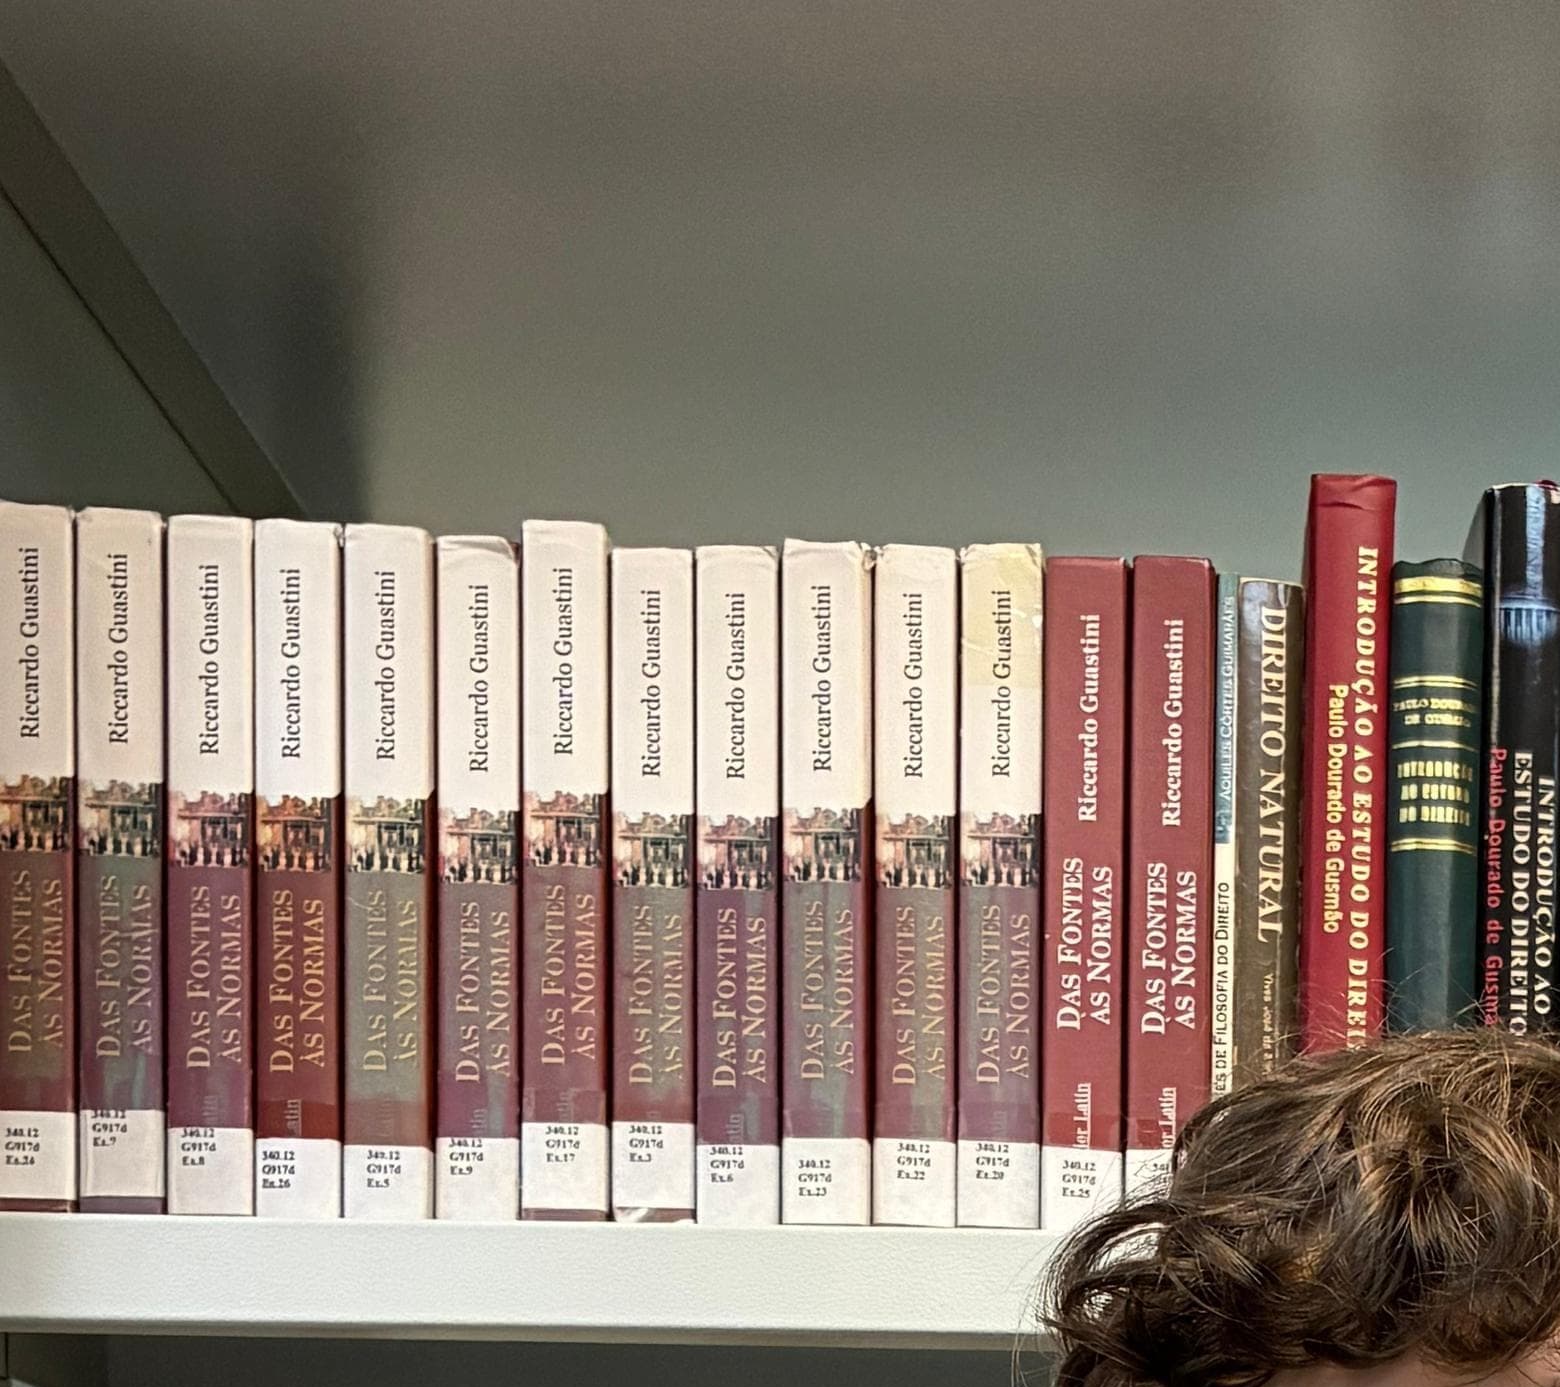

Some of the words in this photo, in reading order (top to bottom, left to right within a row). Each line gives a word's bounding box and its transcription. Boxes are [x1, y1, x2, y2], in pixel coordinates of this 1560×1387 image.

[18, 547, 39, 639] Guastini
[279, 569, 301, 659] Guastini
[810, 585, 832, 674] Guastini
[1079, 614, 1100, 713] Guastini
[1257, 604, 1287, 757] DIREITO
[1352, 546, 1379, 736] INTRODUÇÃO
[18, 644, 40, 738] Riccardo
[280, 664, 301, 758] Riccardo
[811, 679, 832, 772] Riccardo
[1328, 684, 1350, 738] Paulo
[1077, 718, 1098, 821] Riccardo
[1326, 743, 1347, 824] Dourado
[1353, 744, 1373, 784] AO
[1513, 752, 1533, 865] ESTUDO
[1257, 768, 1285, 943] NATURAL
[1325, 828, 1344, 852] de
[1350, 791, 1373, 902] ESTUDO
[1533, 778, 1556, 968] INTRODUÇÃO
[1057, 857, 1084, 965] FONTES
[1088, 866, 1113, 983] NORMAS
[1216, 882, 1230, 941] DIREITO
[1323, 857, 1343, 933] Gusmão
[1349, 911, 1370, 950] DO
[1512, 871, 1530, 912] DO
[269, 889, 294, 1002] FONTES
[299, 899, 325, 1023] NORMAS
[1216, 944, 1229, 966] DO
[1509, 918, 1530, 1037] DIREITO
[1056, 974, 1081, 1030] DAS
[1216, 970, 1228, 1046] FILOSOFIA
[1346, 958, 1368, 1051] DIREI
[1534, 974, 1551, 1015] AO
[269, 1014, 294, 1072] DAS
[1216, 1050, 1227, 1069] DE
